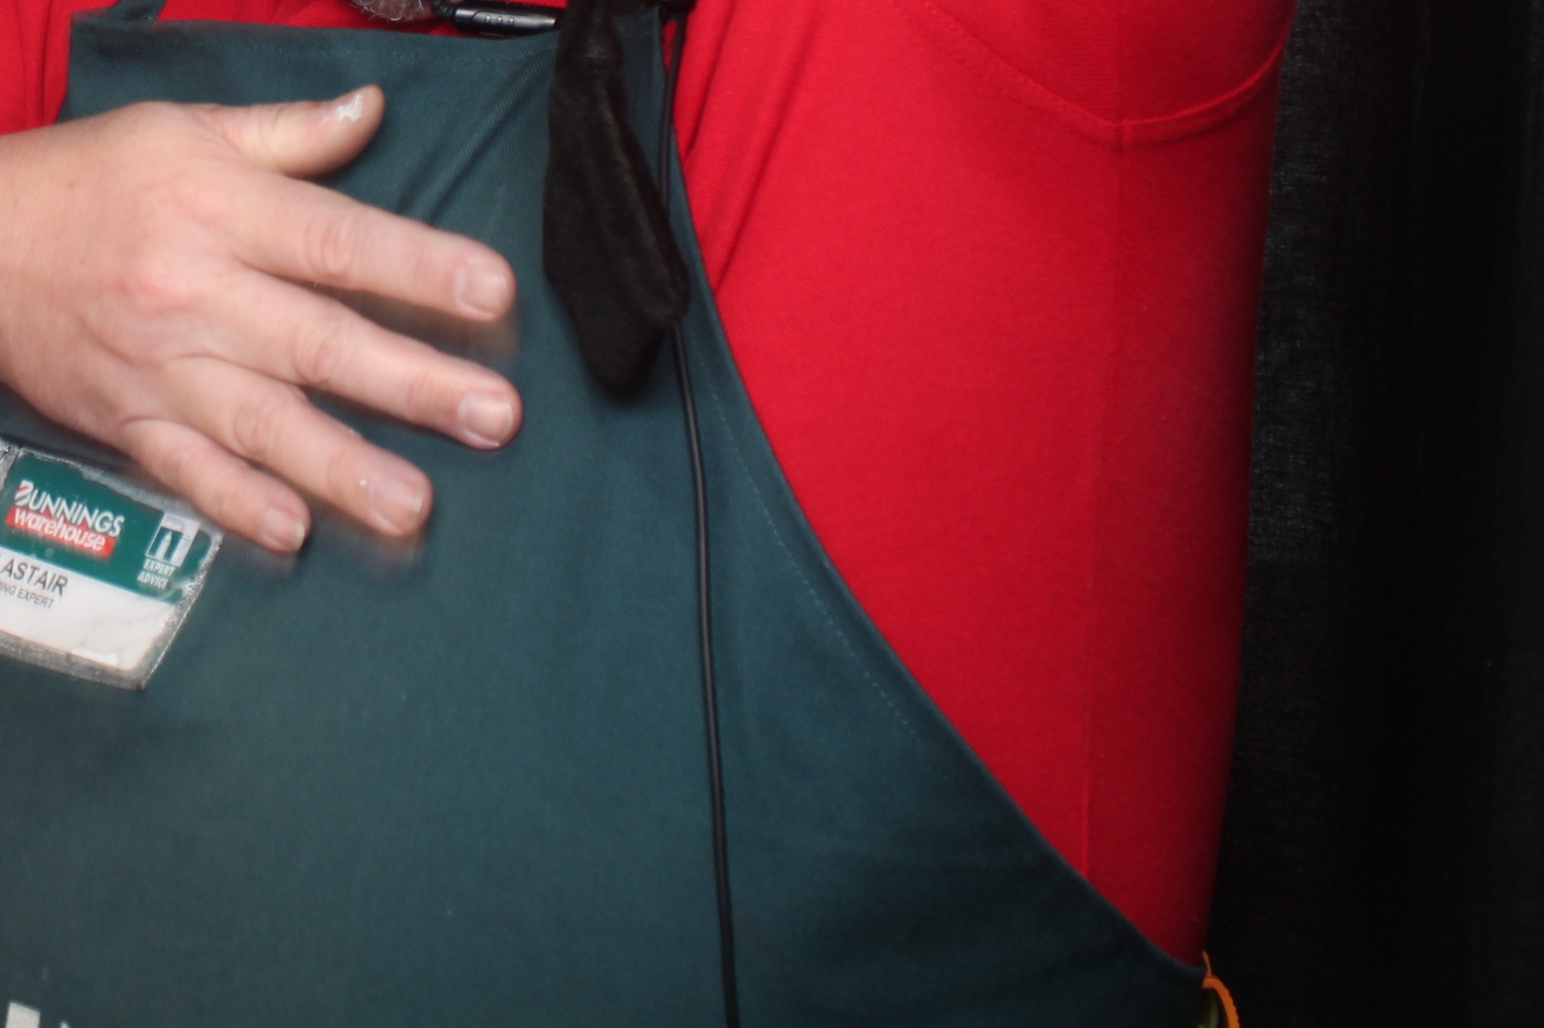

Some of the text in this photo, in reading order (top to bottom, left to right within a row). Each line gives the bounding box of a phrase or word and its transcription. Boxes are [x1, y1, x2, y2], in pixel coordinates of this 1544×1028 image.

[14, 480, 125, 537] BUNNINGS
[14, 508, 106, 551] warehouse
[143, 558, 176, 578] EXPERT
[137, 570, 169, 589] ADVICE
[17, 588, 55, 610] EXPERT
